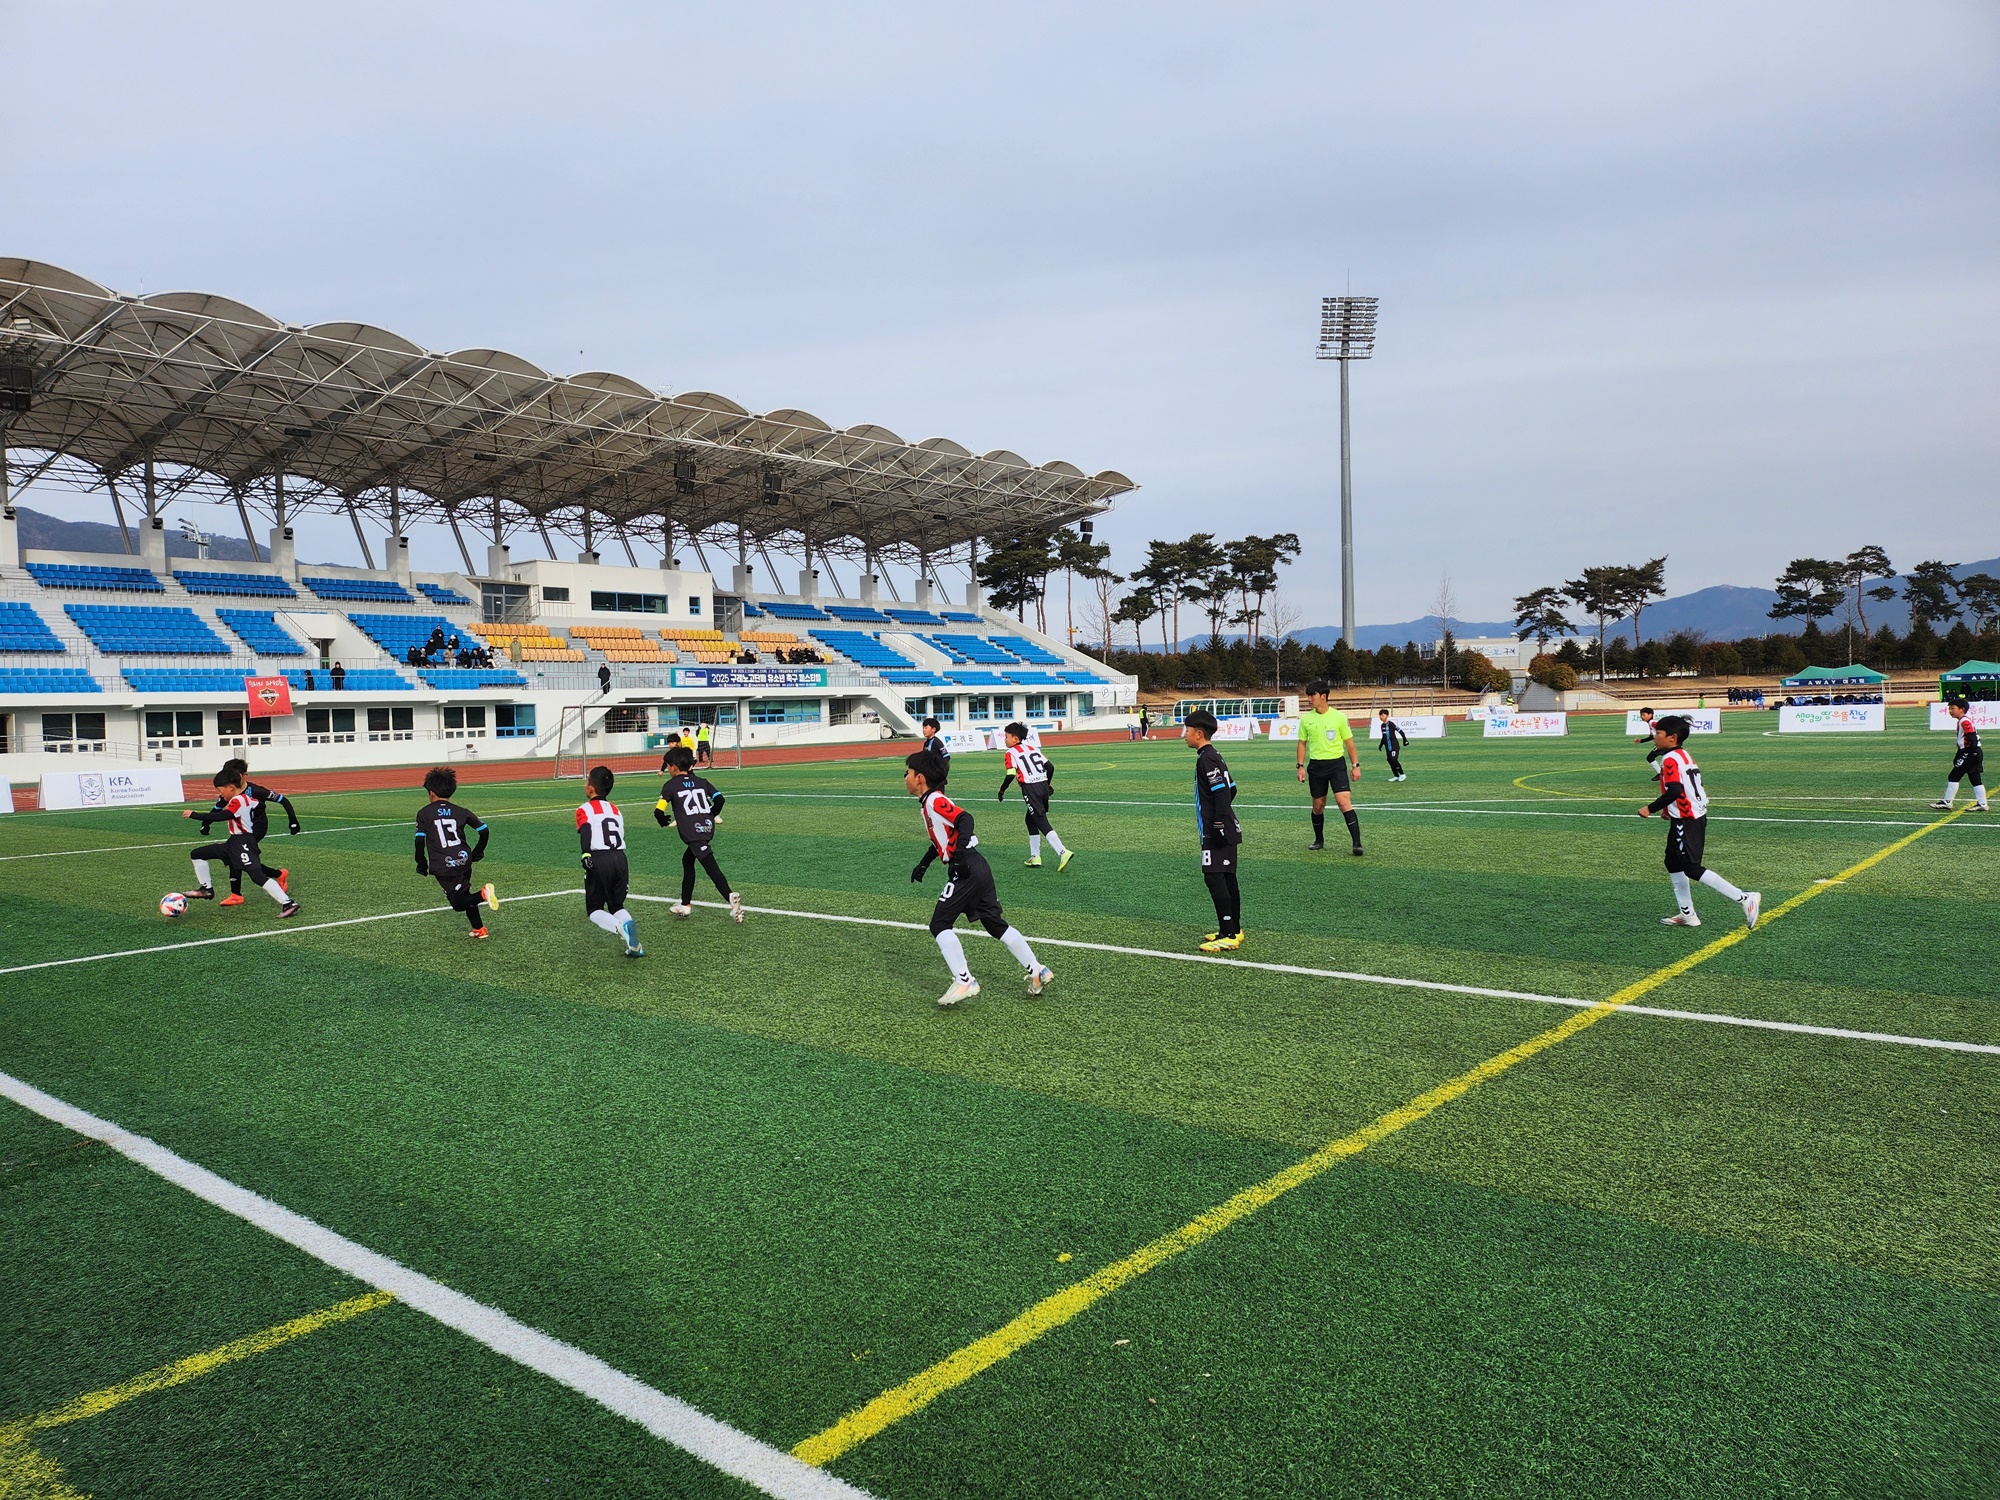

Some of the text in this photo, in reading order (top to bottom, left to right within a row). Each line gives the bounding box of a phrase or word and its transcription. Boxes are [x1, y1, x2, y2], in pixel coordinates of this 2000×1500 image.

[711, 673, 729, 683] 2025
[1490, 719, 1508, 729] 구례
[1542, 717, 1559, 729] 축제
[1694, 721, 1713, 731] 구례
[1018, 752, 1046, 777] 16
[109, 776, 133, 787] KFA
[677, 788, 711, 816] 20
[437, 808, 451, 817] SM
[433, 818, 461, 849] 13
[601, 817, 622, 849] 6
